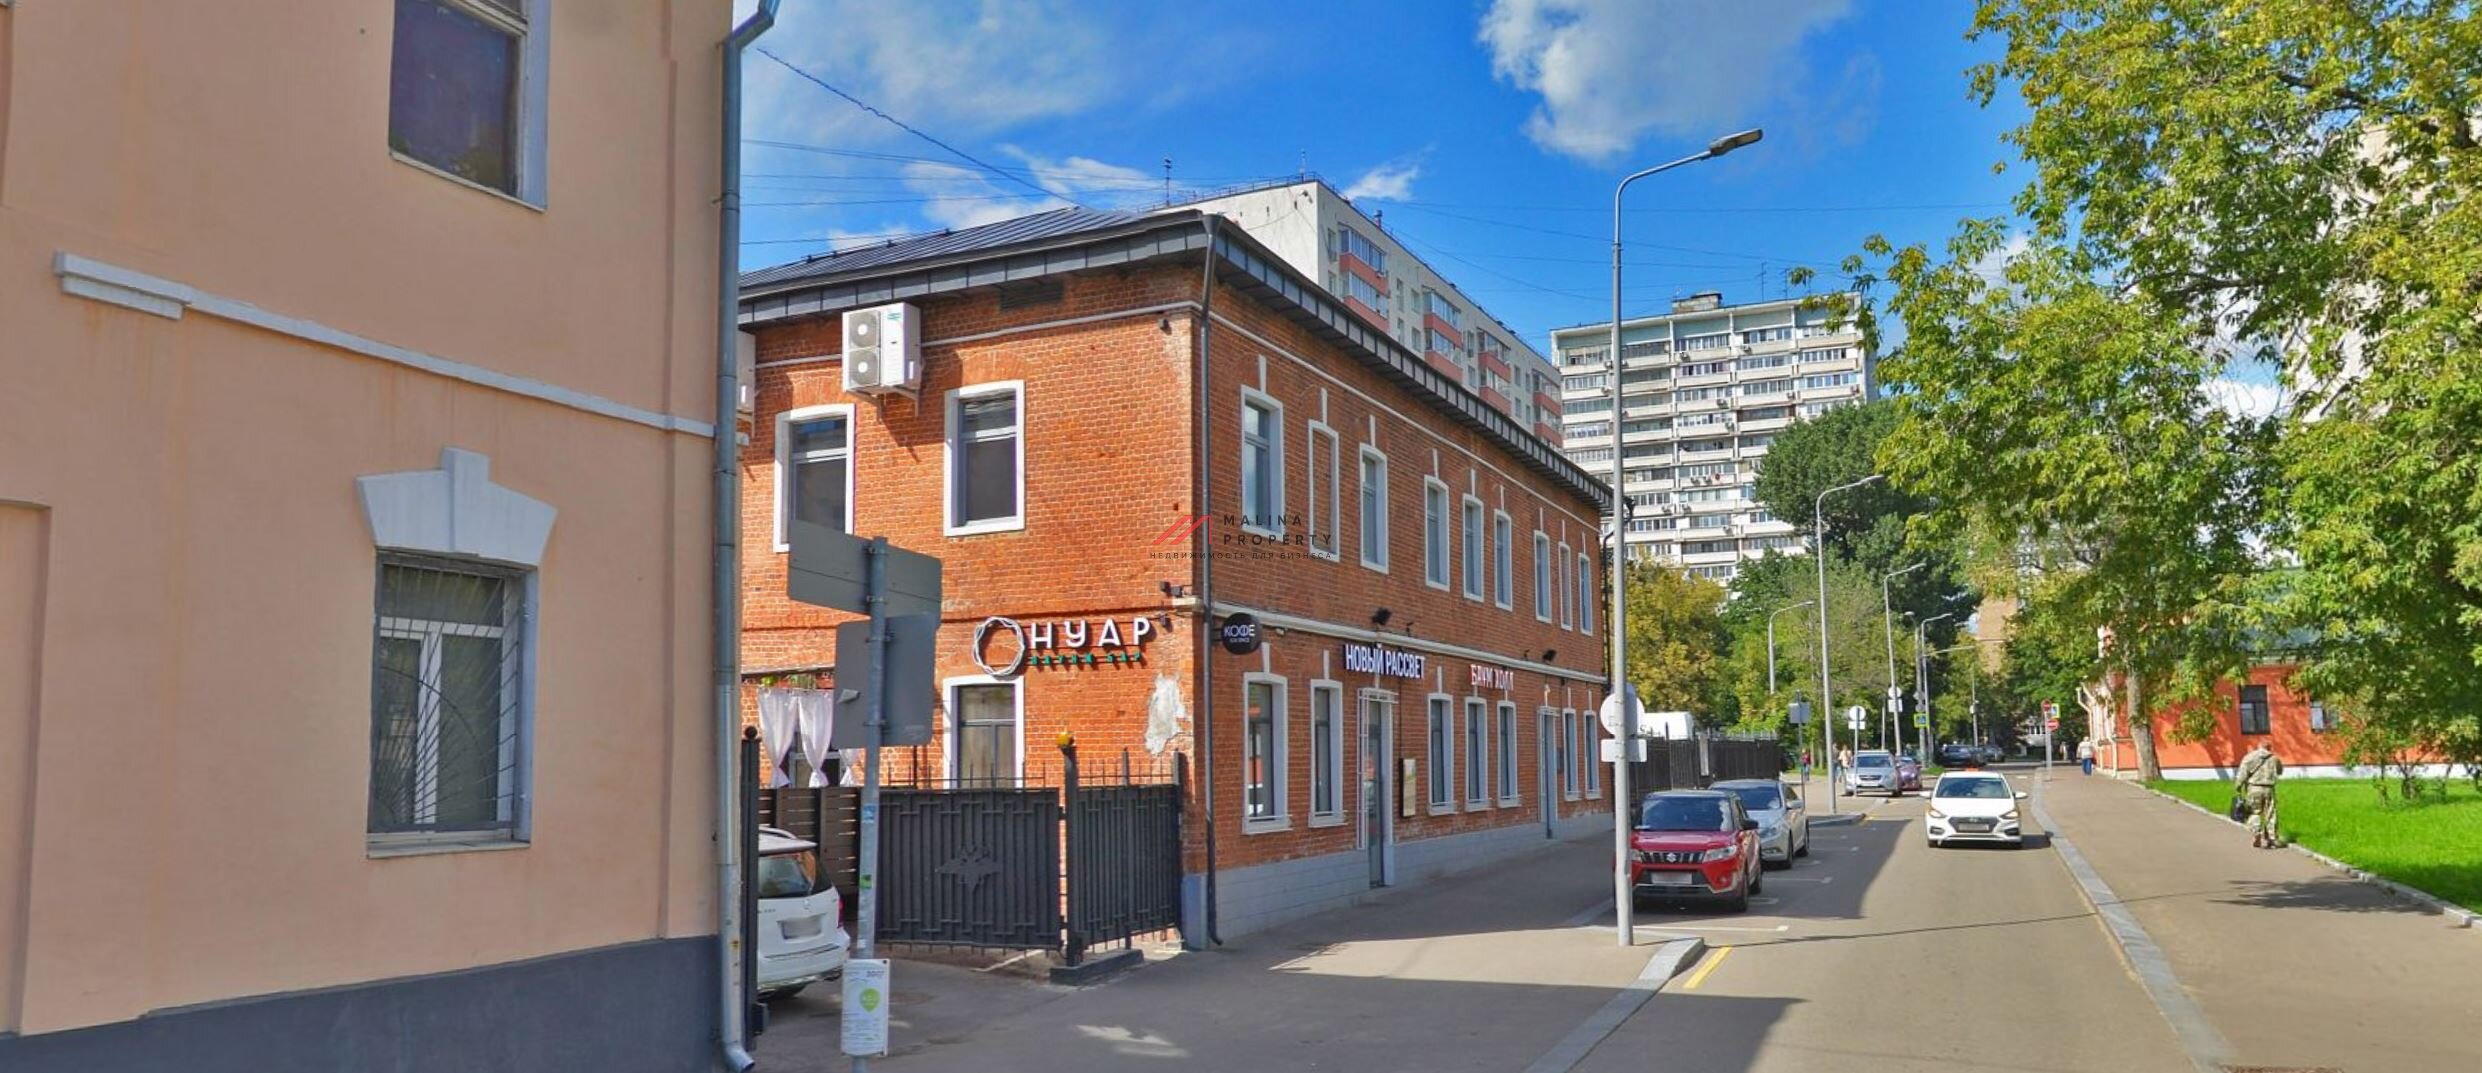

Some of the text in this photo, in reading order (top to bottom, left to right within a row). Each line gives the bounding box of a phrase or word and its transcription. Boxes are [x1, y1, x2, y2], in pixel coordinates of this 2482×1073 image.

[1224, 624, 1256, 637] КОФЕ
[1345, 642, 1426, 679] НОВЫЙ РАССВЕТ
